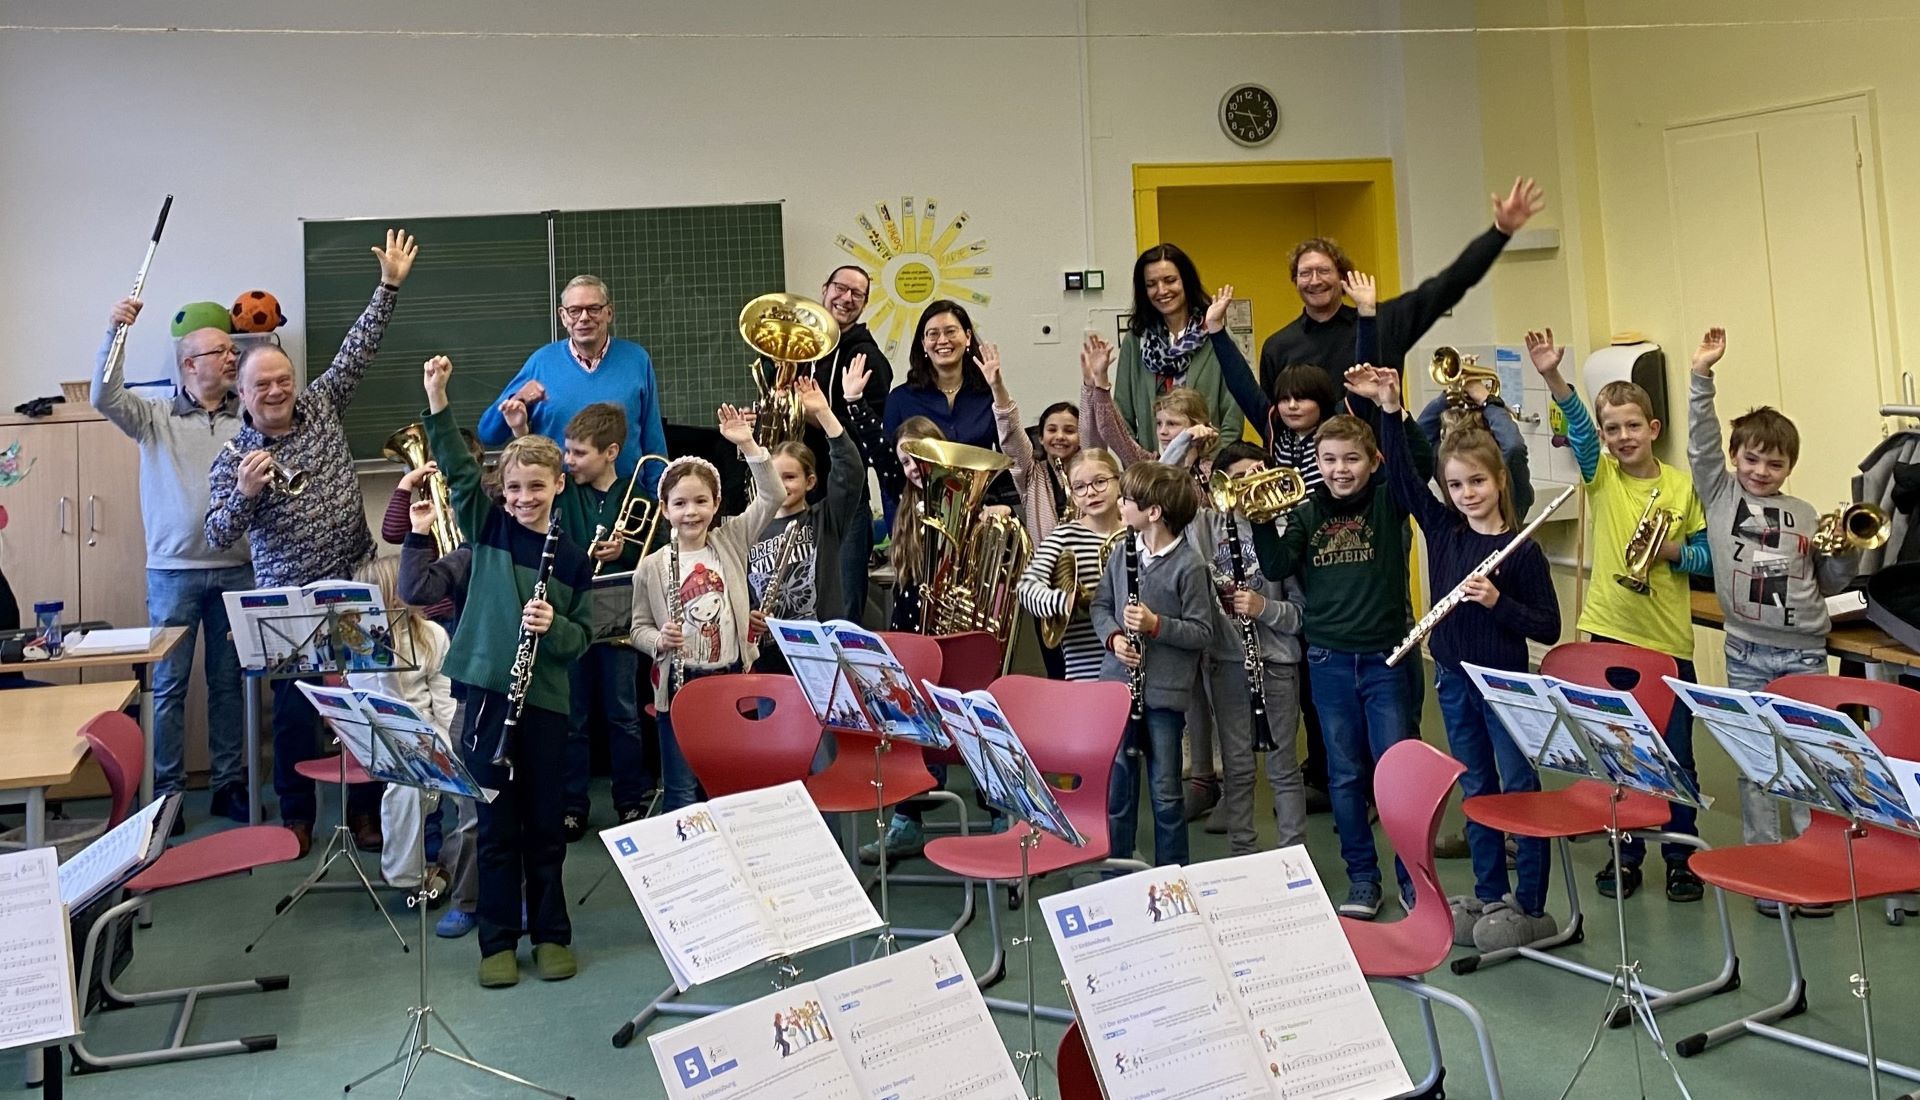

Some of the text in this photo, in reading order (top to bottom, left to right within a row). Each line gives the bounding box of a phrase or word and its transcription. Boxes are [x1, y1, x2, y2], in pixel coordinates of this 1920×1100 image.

[1245, 91, 1253, 99] 12
[1257, 93, 1261, 102] 1
[1229, 102, 1237, 110] 10
[1263, 101, 1269, 109] 2
[1267, 110, 1272, 118] 3
[1232, 122, 1237, 130] 8
[1265, 120, 1269, 128] 4
[1240, 128, 1245, 136] 7
[1249, 131, 1255, 139] 6
[1733, 541, 1745, 562] Z
[1784, 607, 1796, 627] E
[1065, 914, 1079, 931] 5
[684, 1058, 700, 1079] 5
